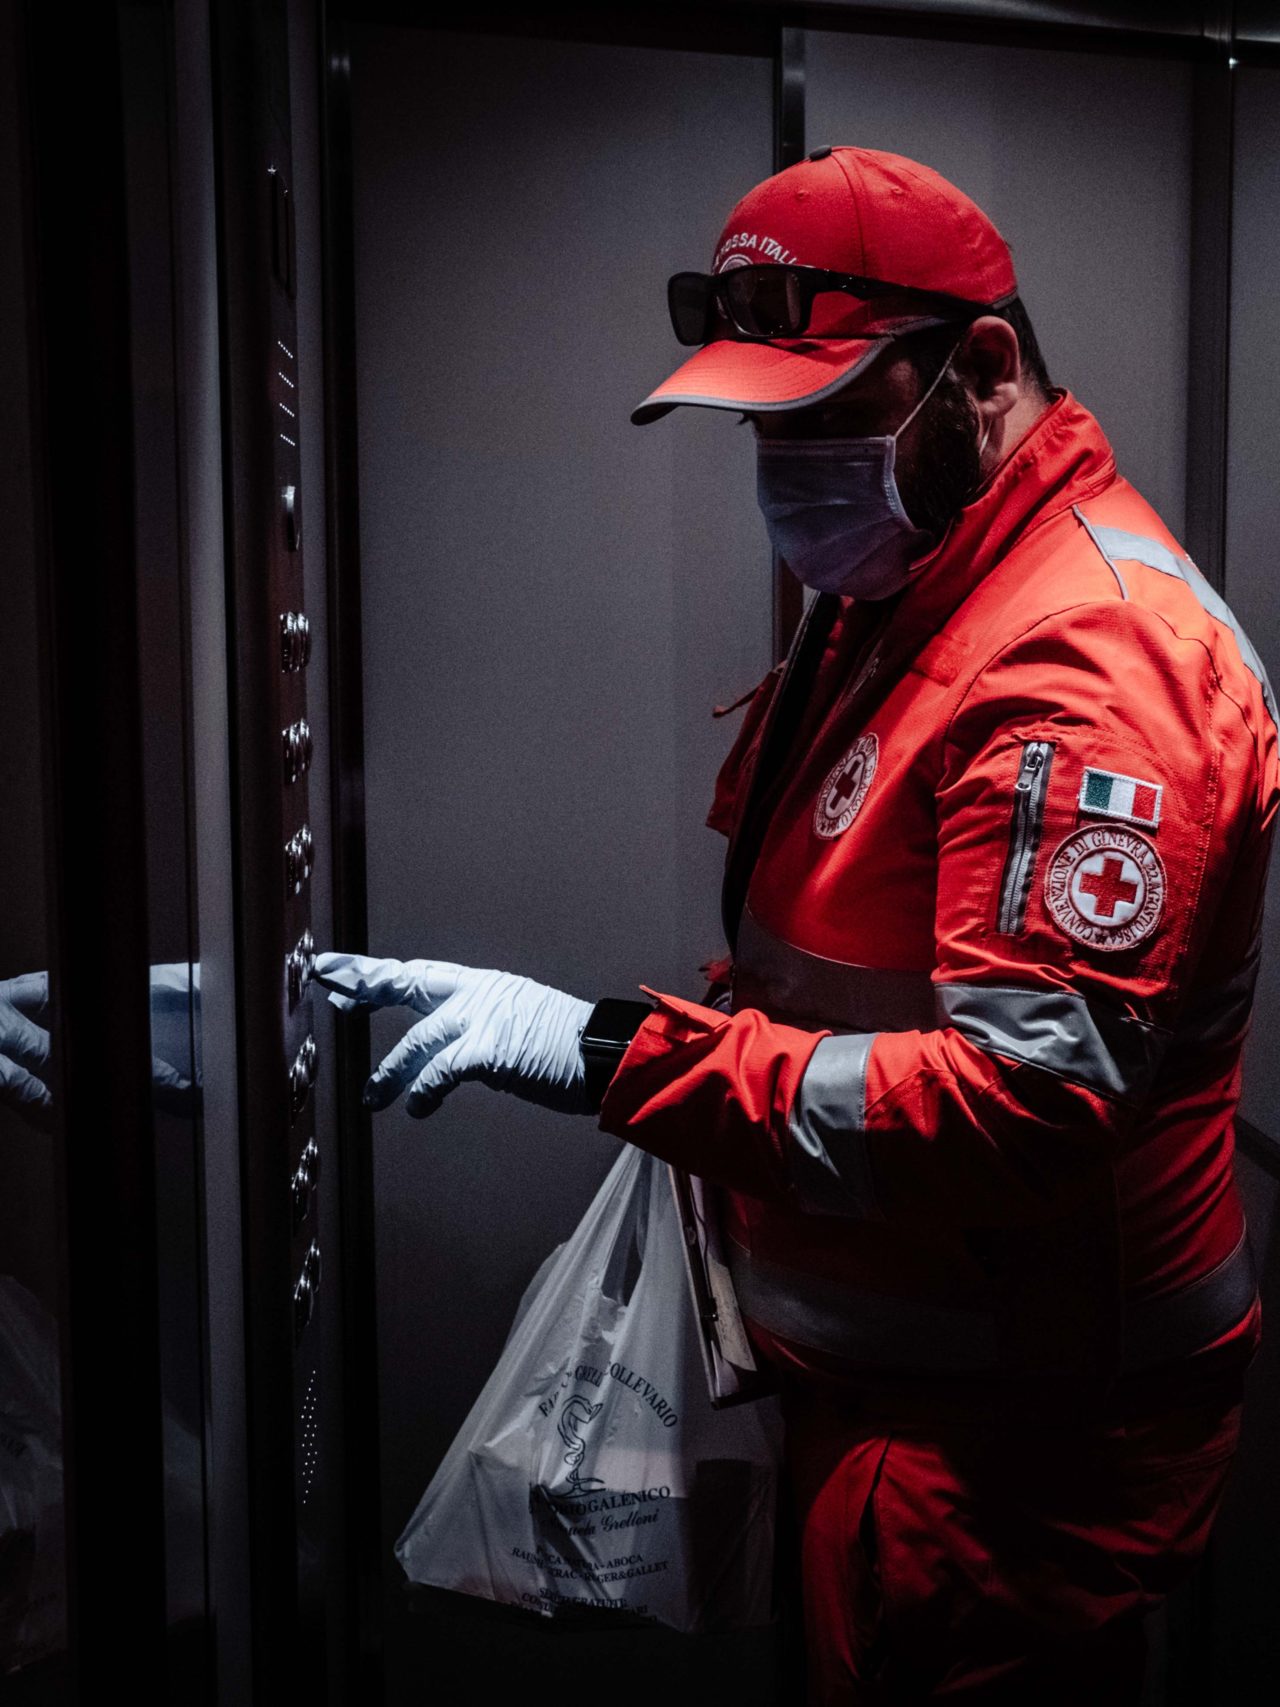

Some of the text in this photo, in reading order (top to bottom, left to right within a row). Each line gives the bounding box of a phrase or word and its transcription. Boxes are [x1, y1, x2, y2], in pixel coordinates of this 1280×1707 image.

[1051, 851, 1094, 941] CONVENZIONE
[1073, 838, 1090, 857] DI
[1091, 829, 1149, 865] GINEVRA
[1144, 863, 1159, 881] 22
[609, 1361, 679, 1428] OLLEVARIO
[606, 1554, 643, 1570] ABOCA
